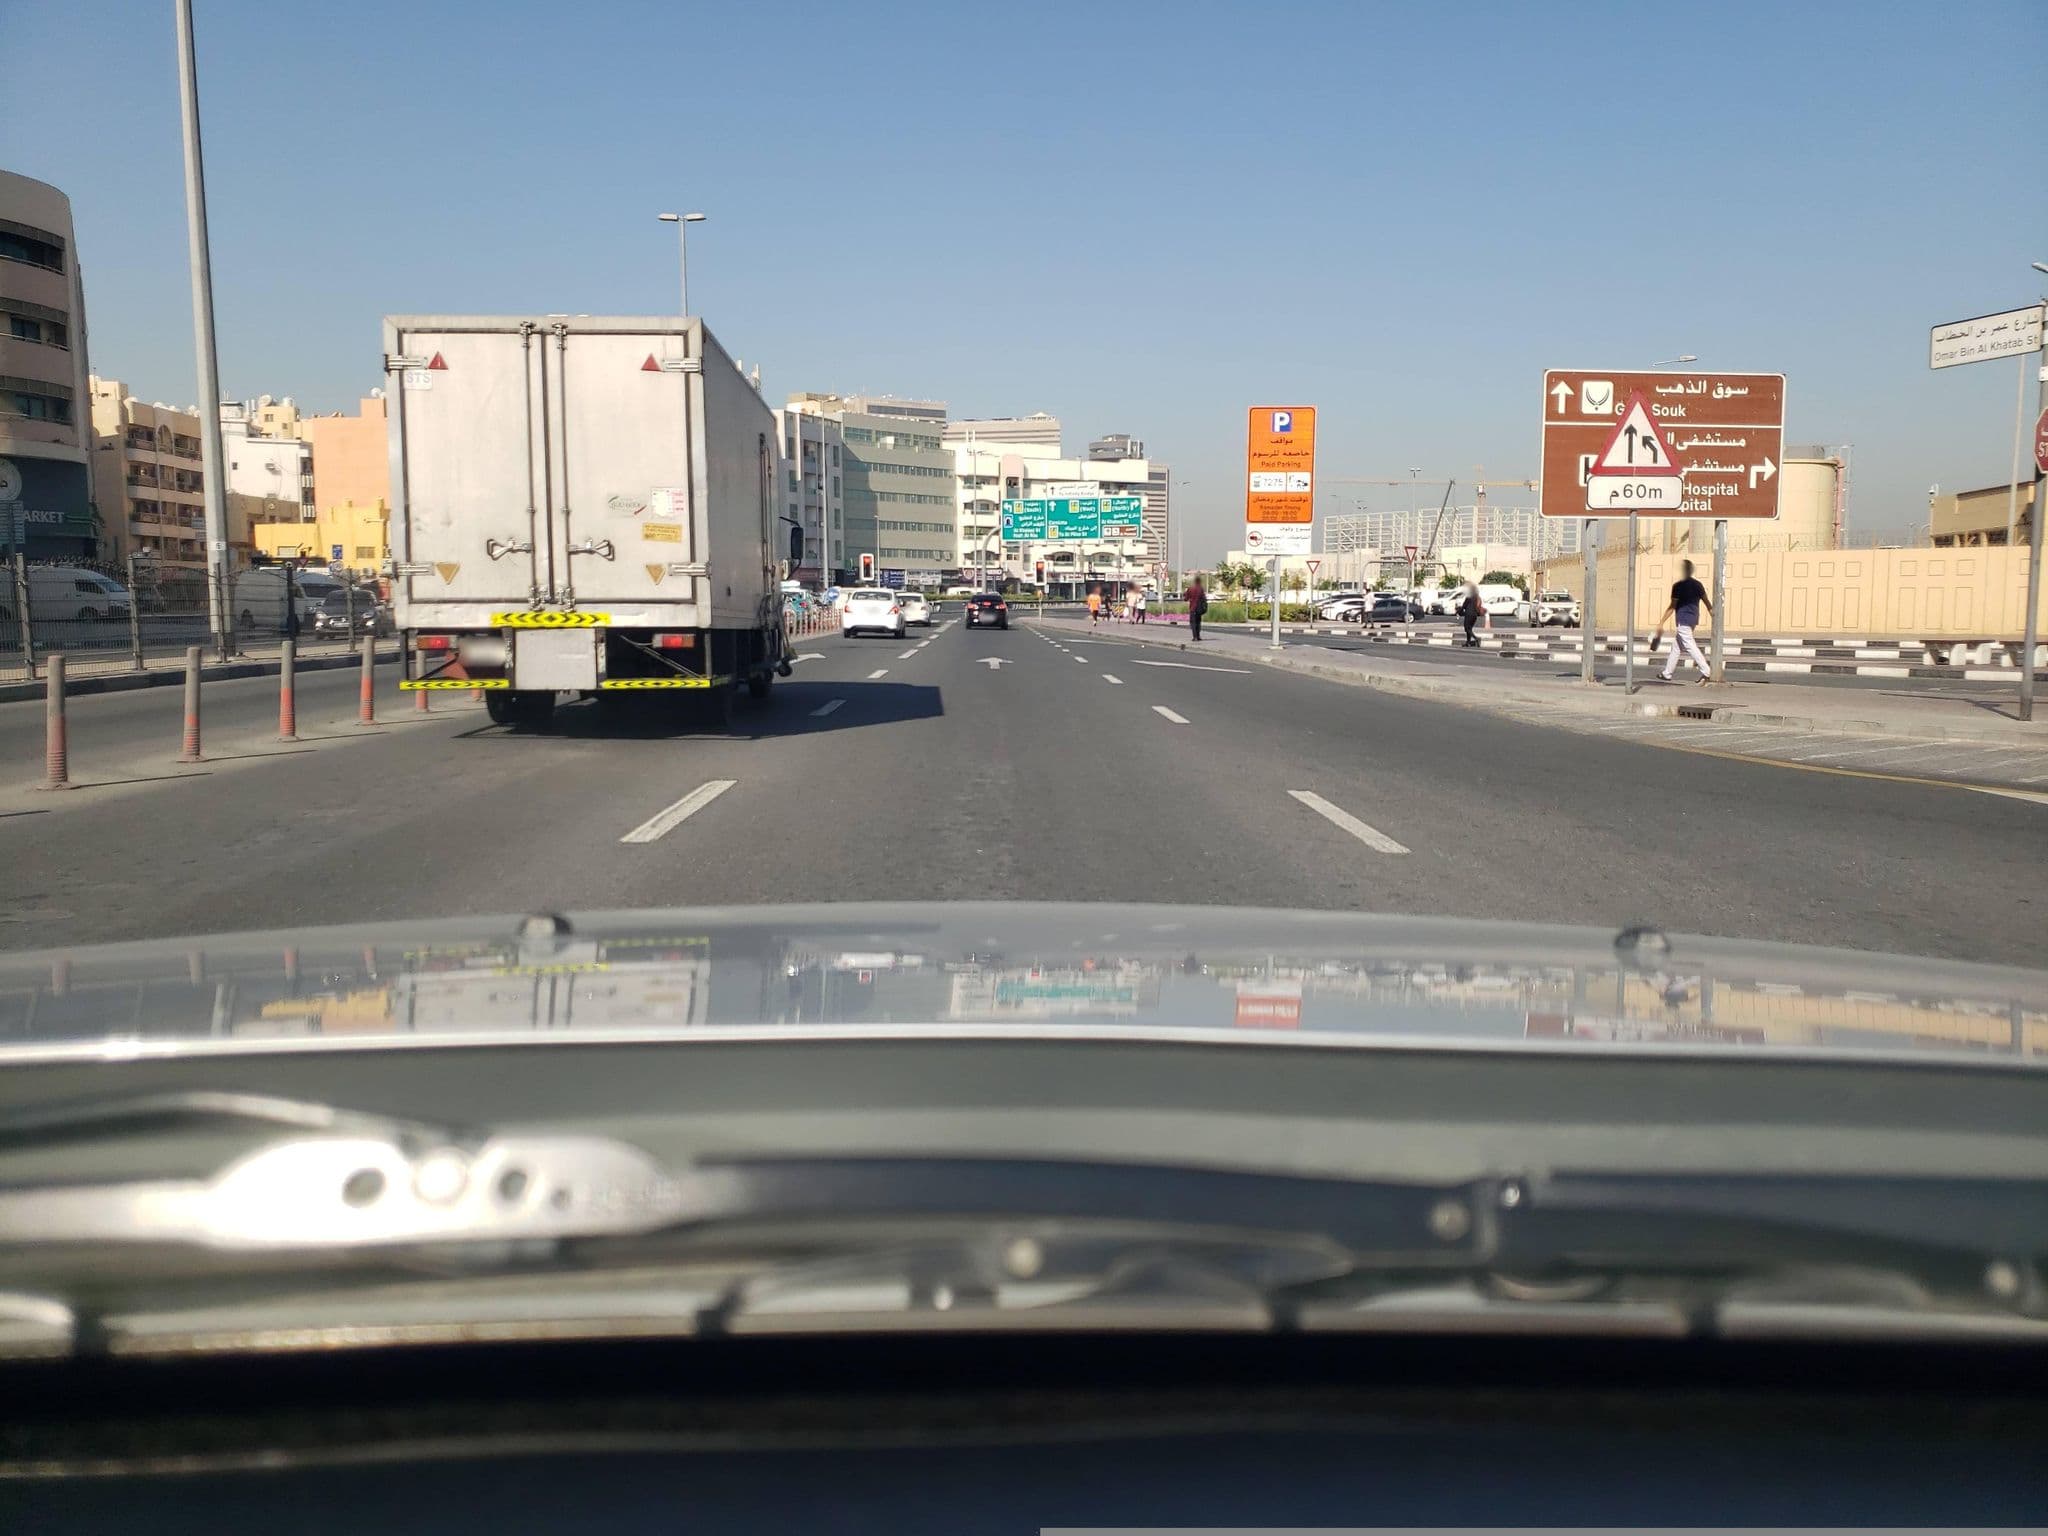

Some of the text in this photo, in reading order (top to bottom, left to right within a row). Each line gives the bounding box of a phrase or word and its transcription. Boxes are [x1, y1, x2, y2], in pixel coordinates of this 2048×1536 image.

[1936, 314, 2039, 342] شارع عمر بن الخطاب
[1935, 335, 2039, 361] Omar Bin Al Khatab St
[1655, 379, 1749, 399] سوق الذهب
[1651, 403, 1687, 417] Souk
[1274, 412, 1291, 432] P
[1676, 432, 1746, 450] مستشفى
[1277, 460, 1301, 469] Parking
[1682, 482, 1739, 497] Hospital
[1681, 498, 1712, 512] pital
[23, 510, 64, 523] ARKET
